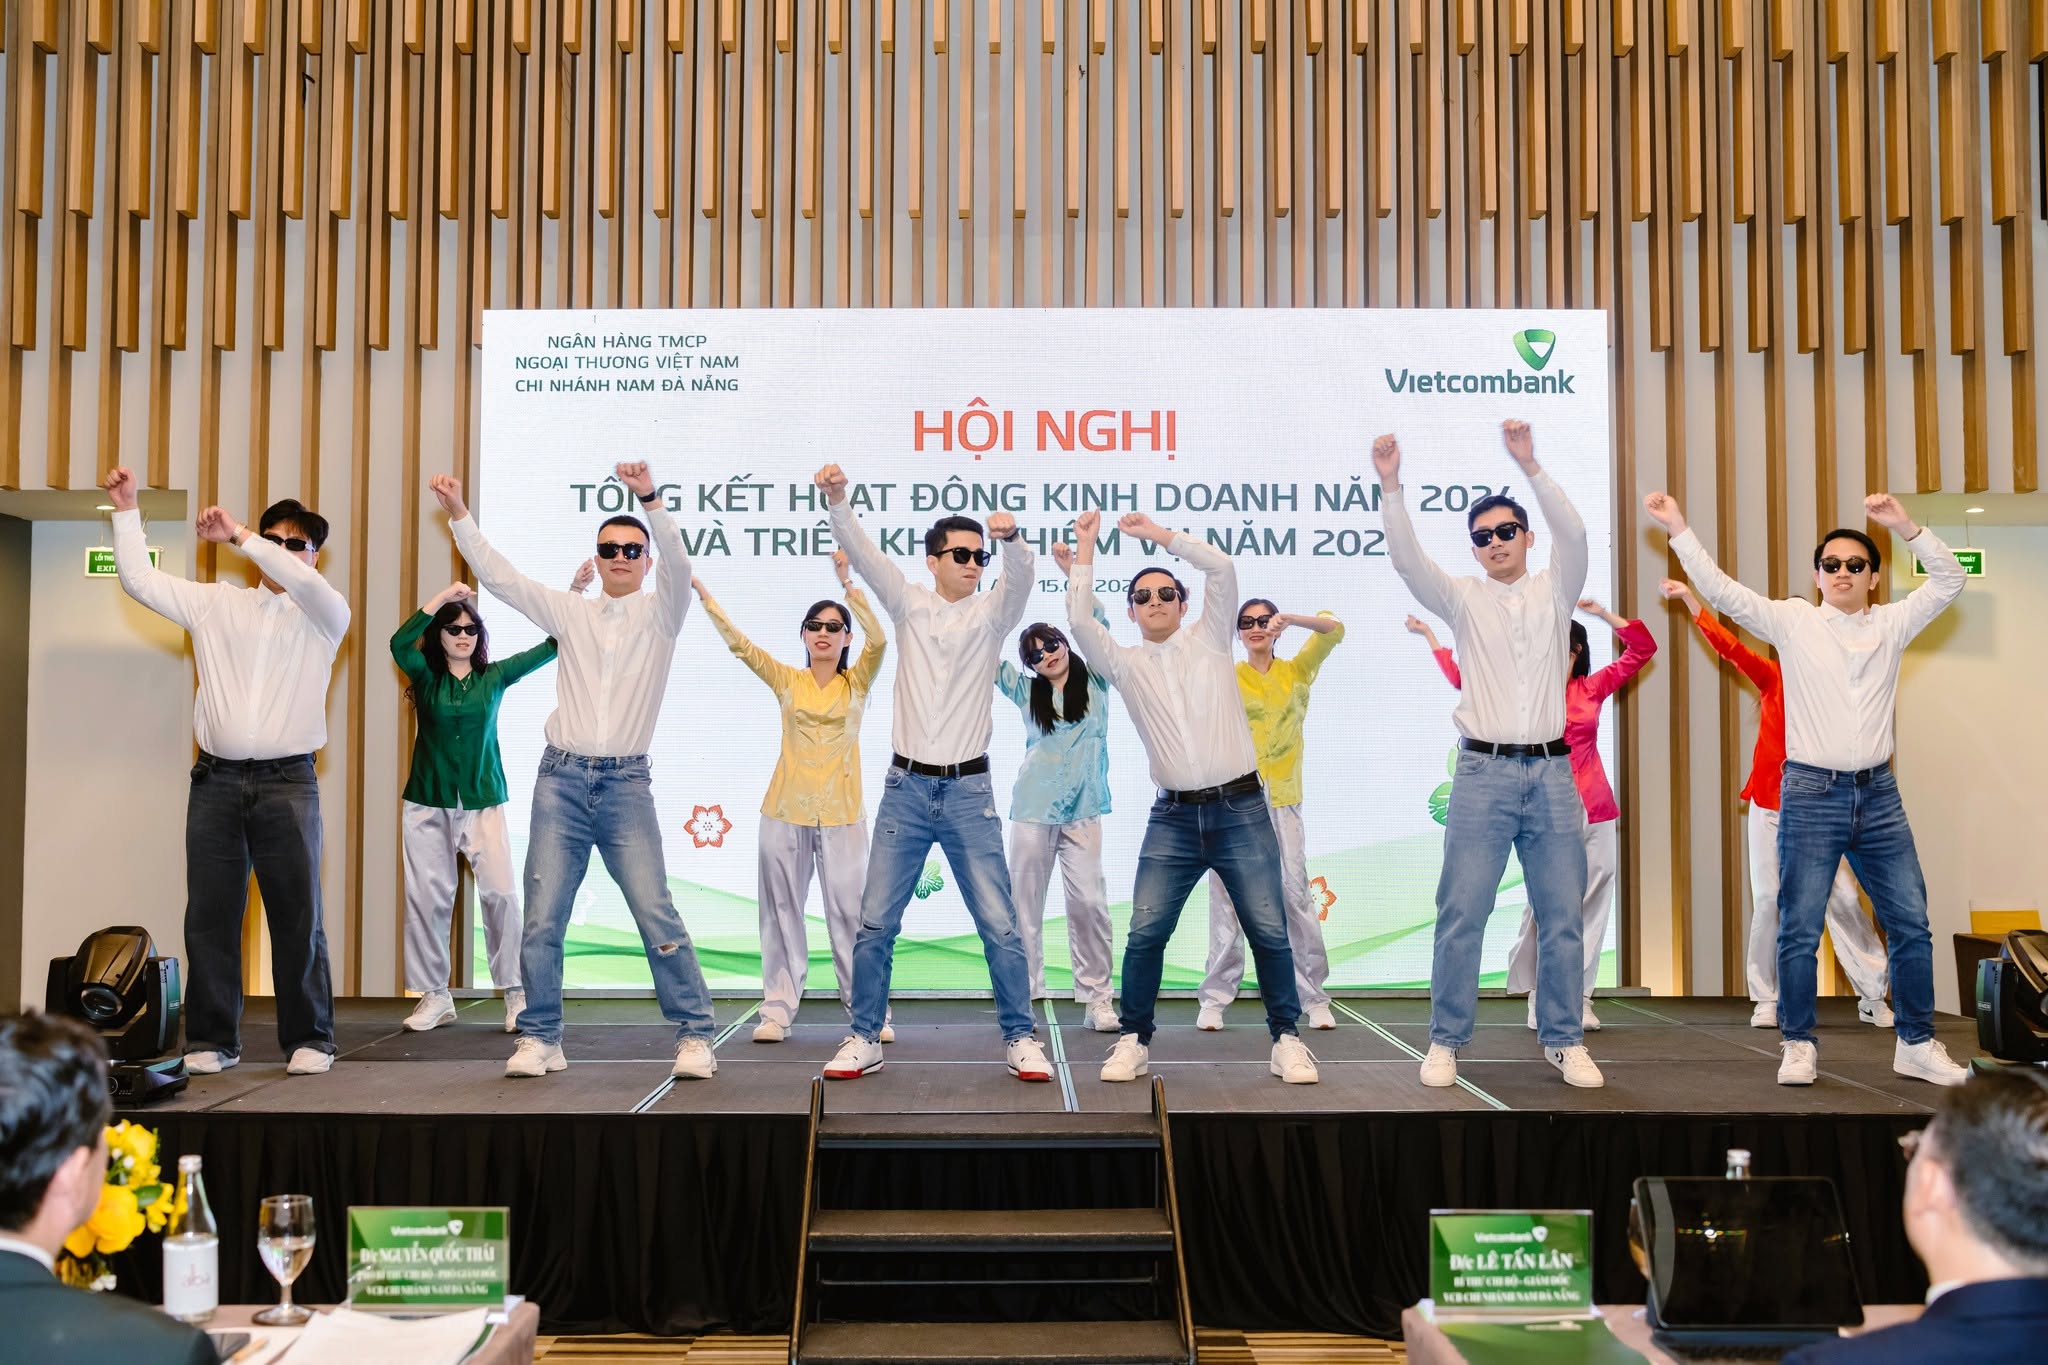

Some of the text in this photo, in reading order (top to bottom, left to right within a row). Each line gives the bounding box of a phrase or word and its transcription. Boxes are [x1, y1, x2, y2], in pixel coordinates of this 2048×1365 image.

[548, 332, 707, 348] NGÂN HÀNG TMCP
[515, 352, 739, 371] NGOẠI THƯƠNG VIỆT NAM
[515, 374, 738, 392] CHI NHÁNH NAM ĐÀ NẴNG
[1384, 368, 1576, 394] Vietcombank
[914, 396, 1176, 460] HỘI NGHỊ
[698, 473, 775, 512] KẾT
[1043, 483, 1138, 512] KINH
[1155, 483, 1298, 512] DOANH
[680, 519, 732, 556] VÀ
[1207, 519, 1297, 556] NĂM
[1313, 529, 1390, 557] 202
